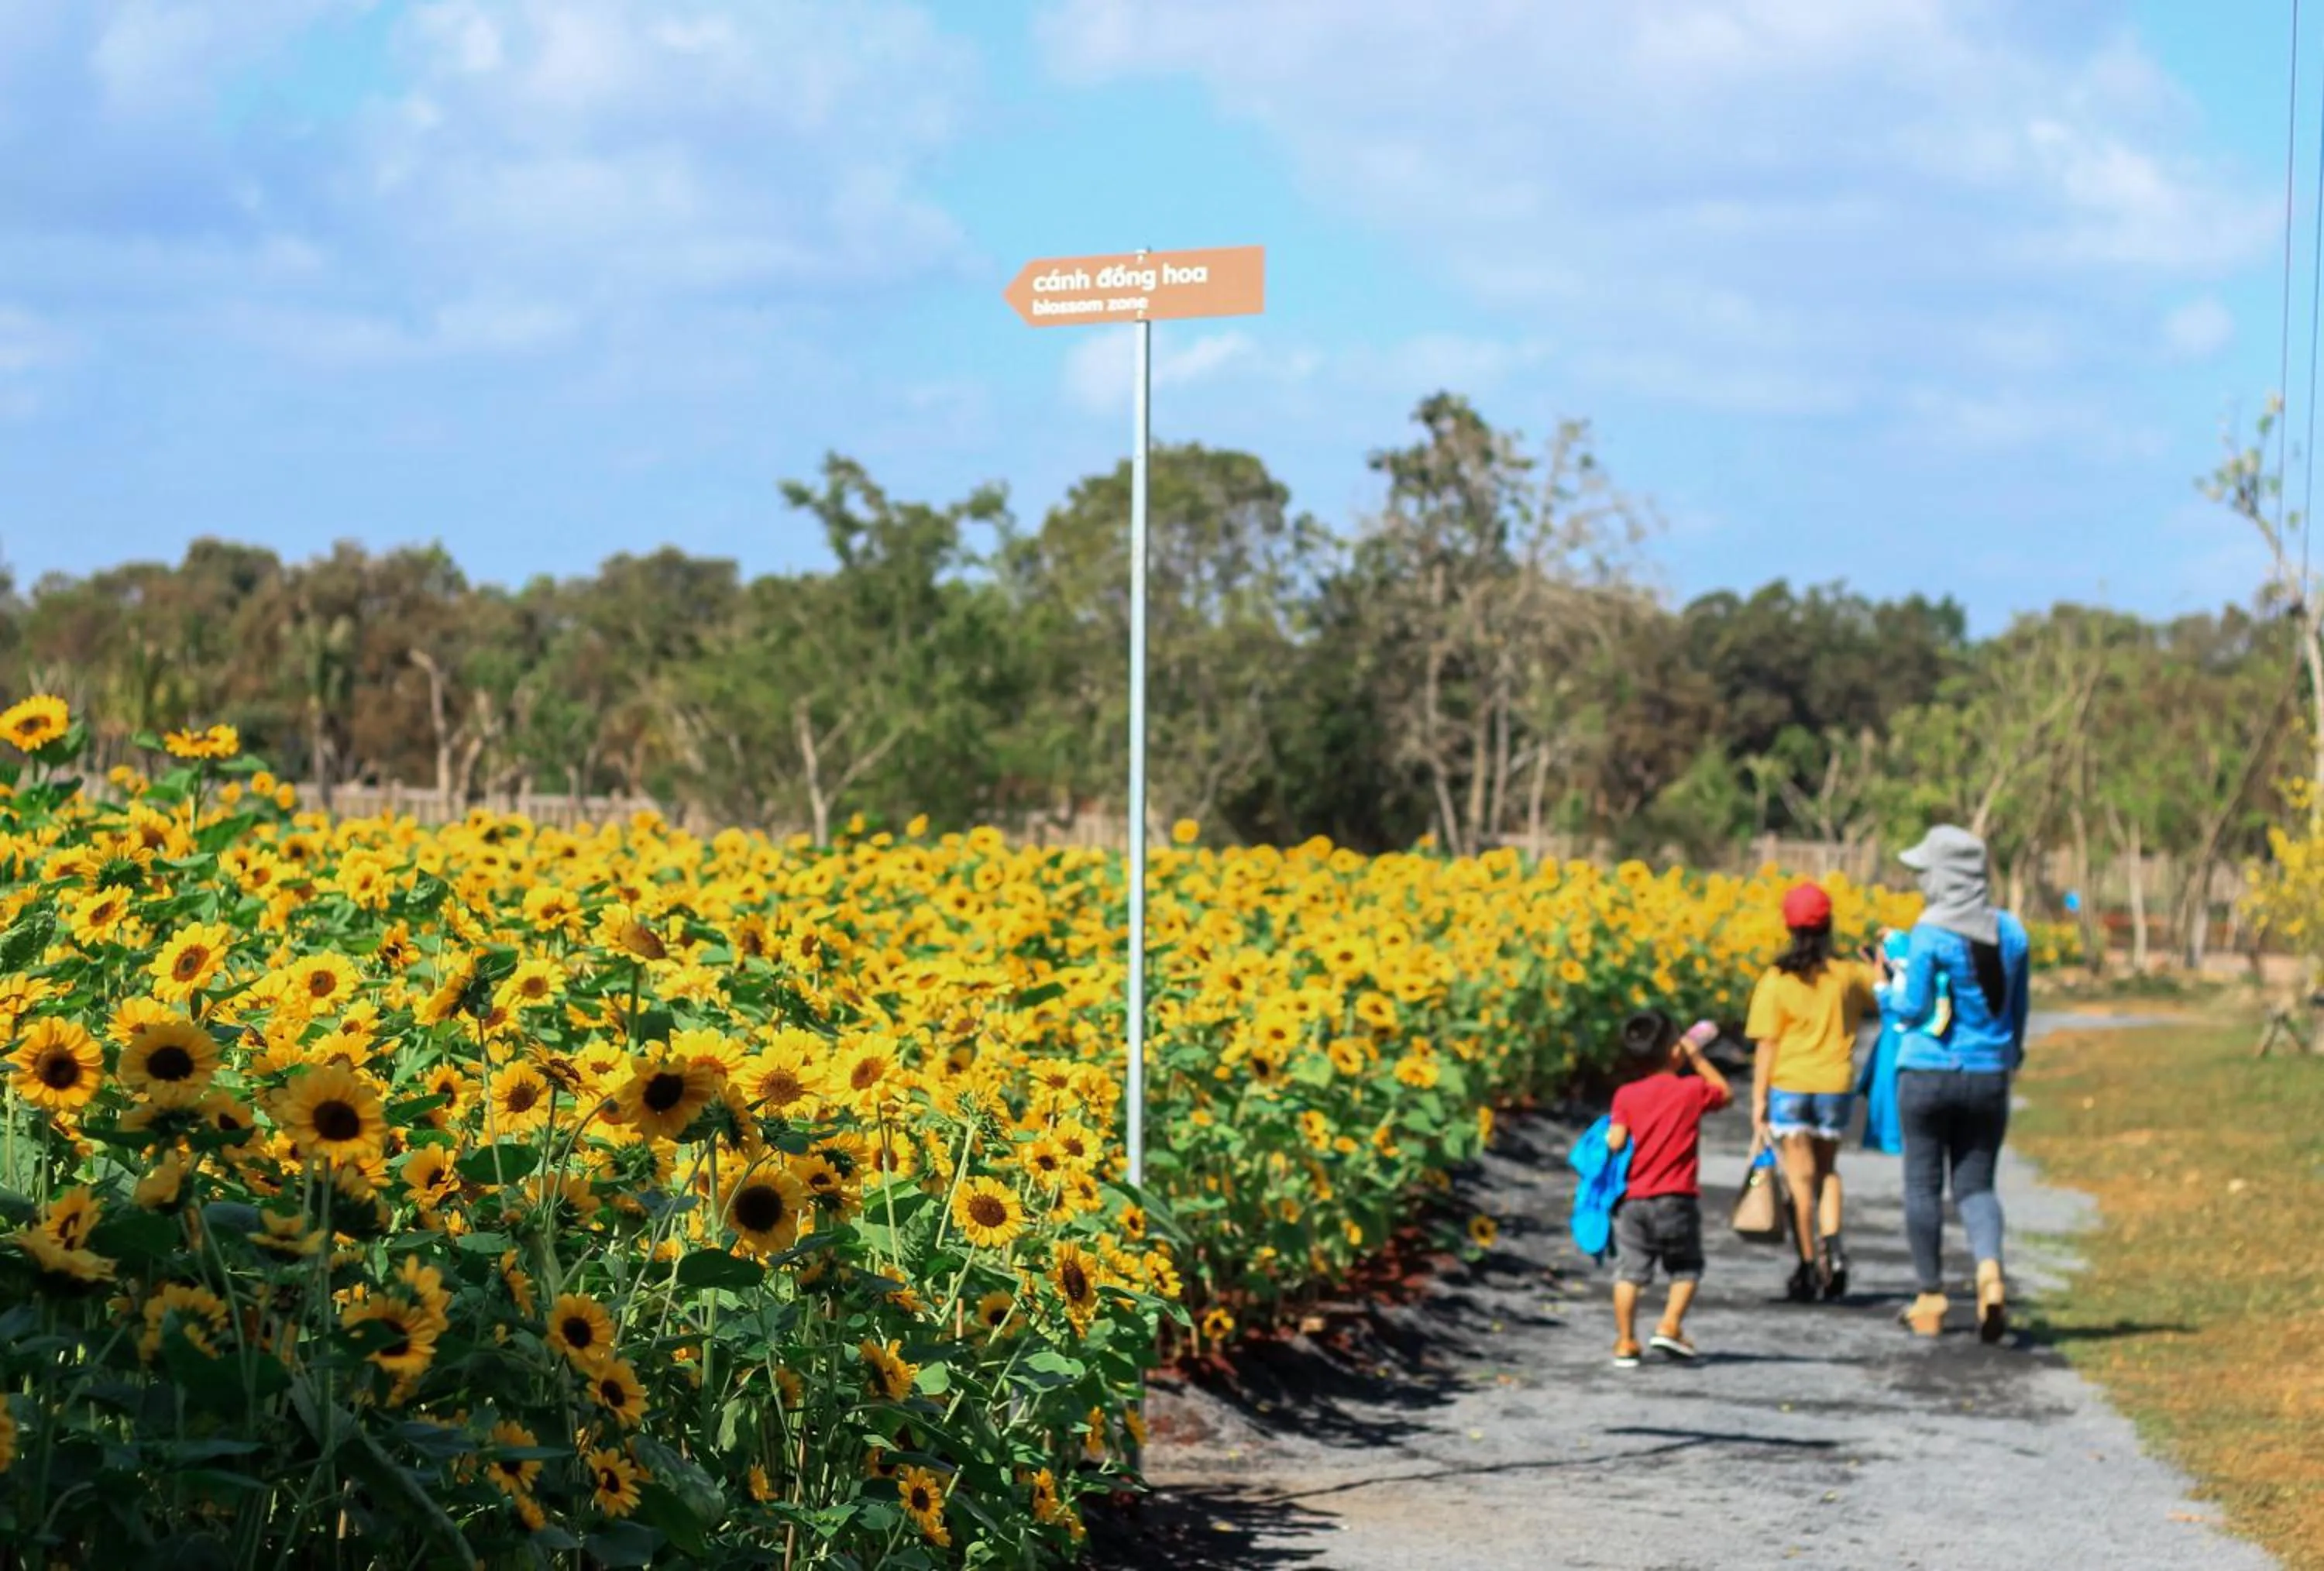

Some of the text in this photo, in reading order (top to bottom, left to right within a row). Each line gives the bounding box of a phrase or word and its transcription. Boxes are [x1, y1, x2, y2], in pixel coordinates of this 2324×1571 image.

[1033, 268, 1090, 292] cánh
[1163, 263, 1208, 284] hoa
[1033, 297, 1148, 315] blossom zone
